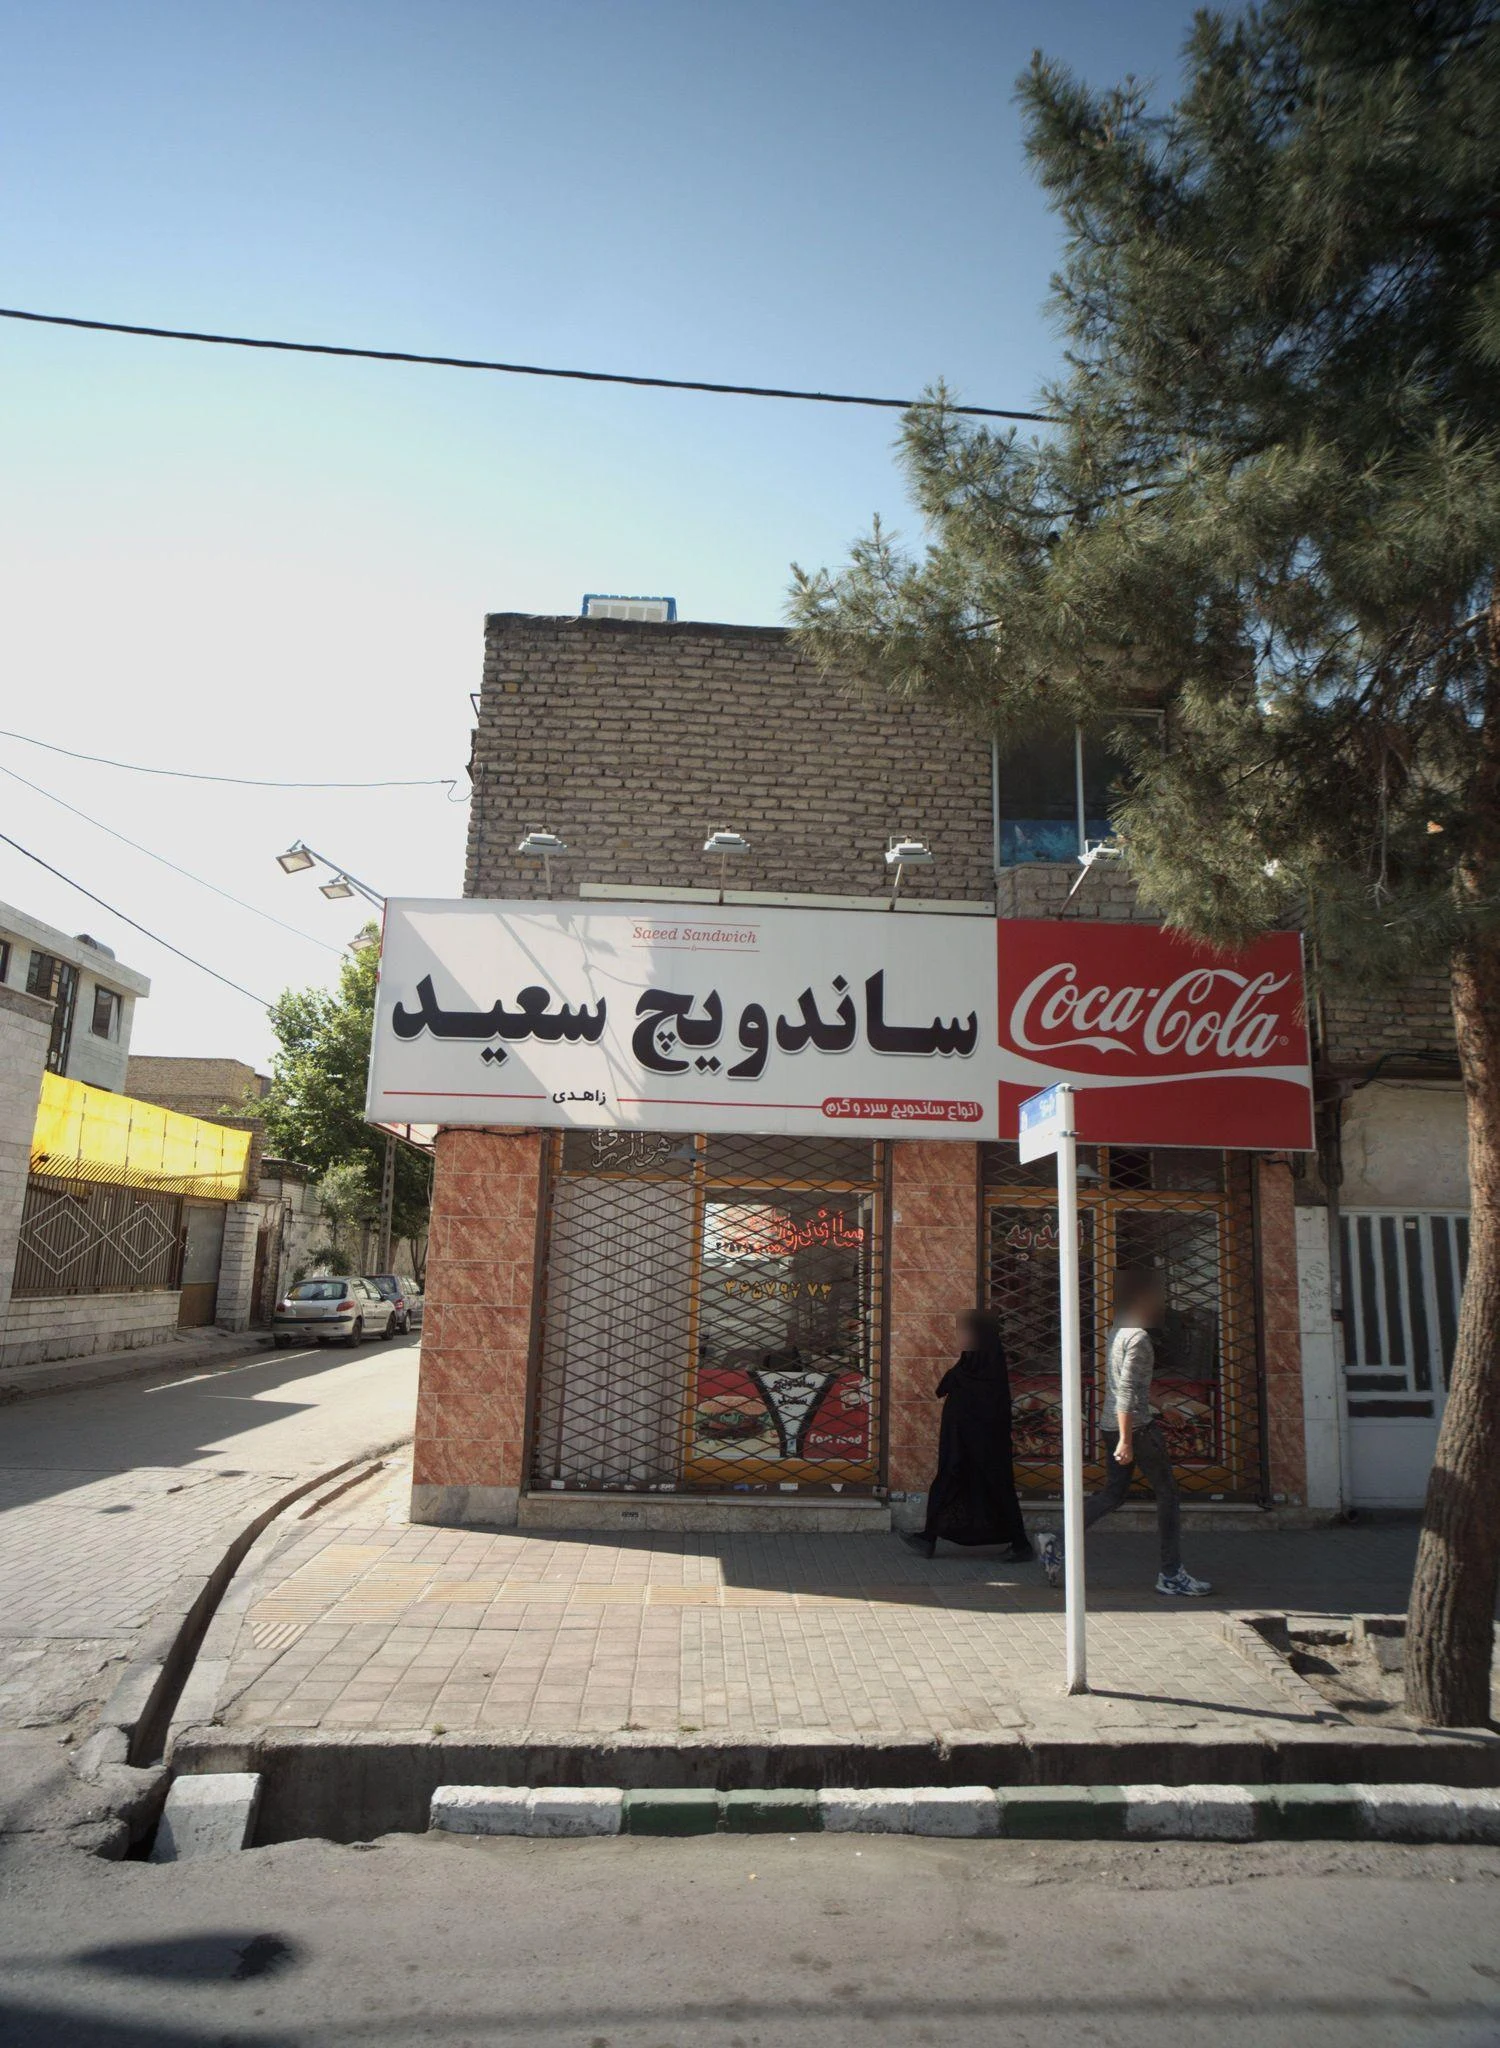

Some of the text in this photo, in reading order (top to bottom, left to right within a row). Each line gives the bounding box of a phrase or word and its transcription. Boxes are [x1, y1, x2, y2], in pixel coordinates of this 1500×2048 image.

[632, 926, 757, 944] Saeed Sandwich
[391, 967, 979, 1081] ساندویچ سعید
[1010, 962, 1292, 1058] Coca-Cola
[553, 1090, 606, 1106] زاهدی
[825, 1098, 979, 1121] انواع ساندویچ سرد و گرم
[1005, 1213, 1084, 1261] اذیه
